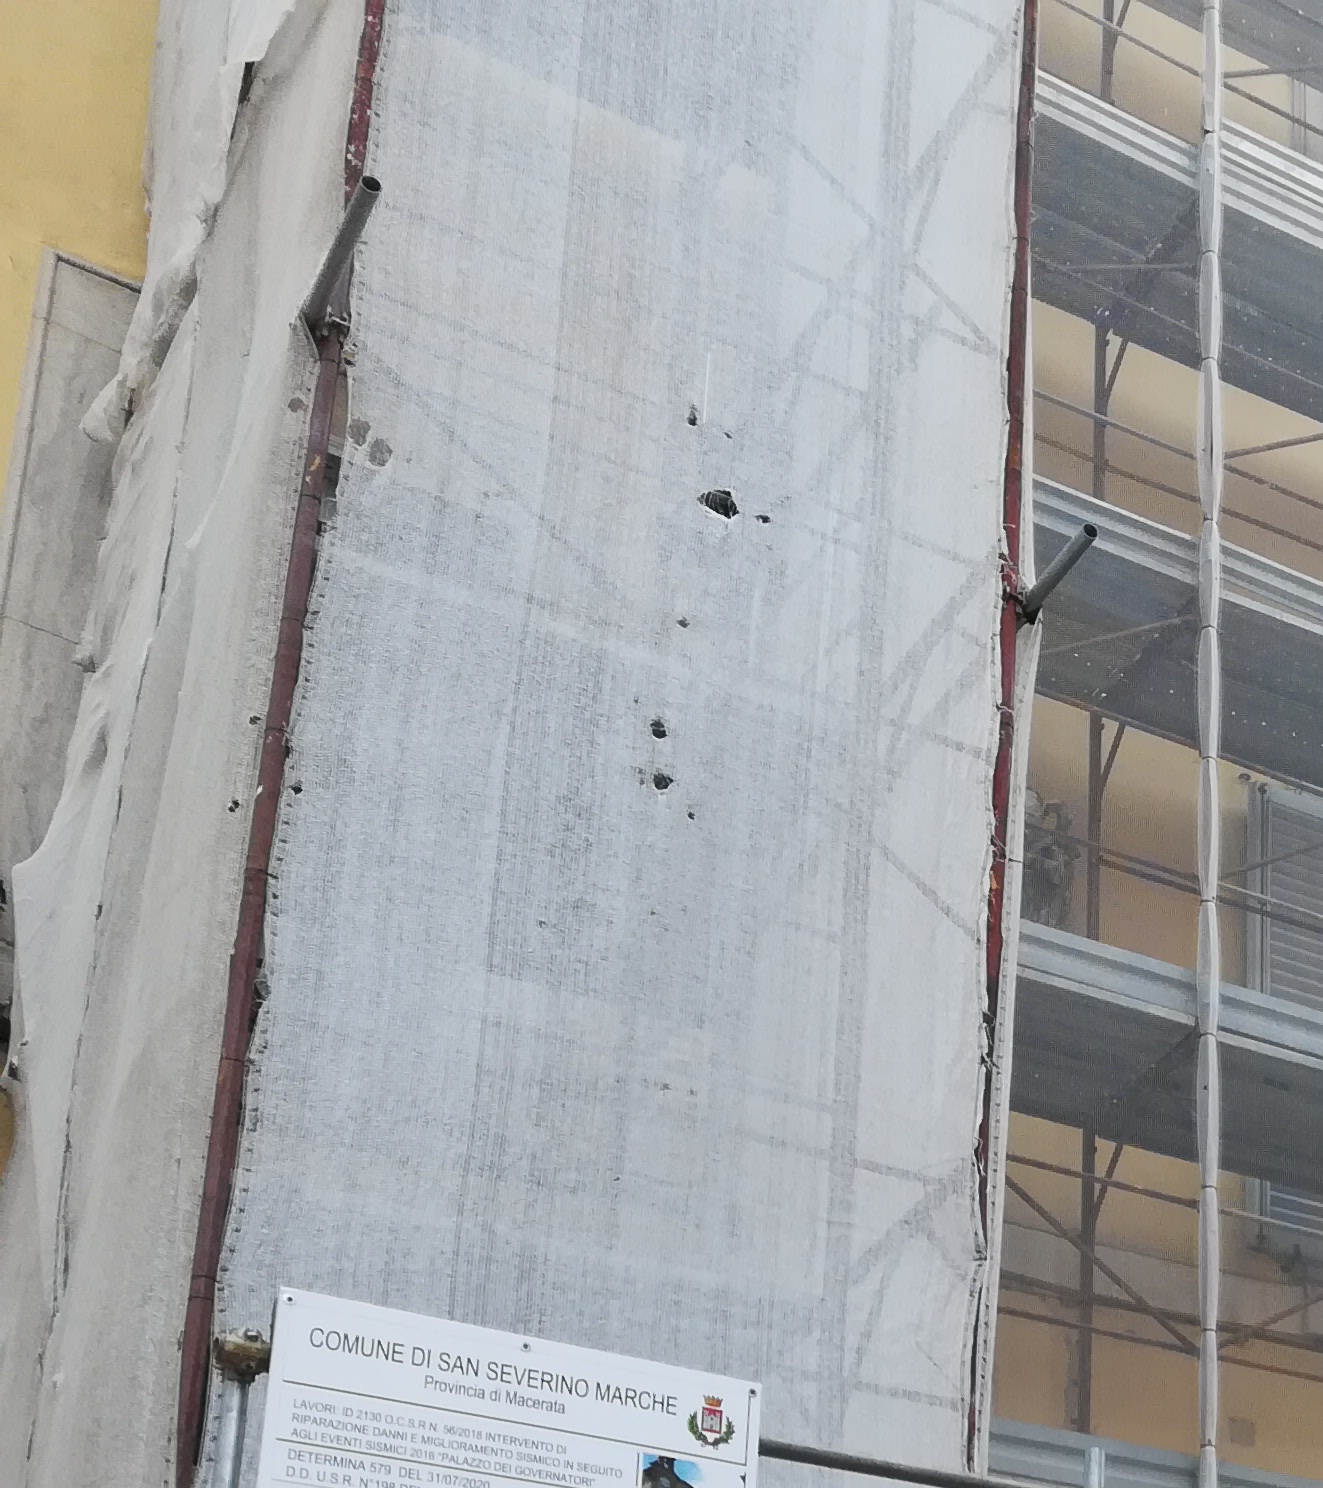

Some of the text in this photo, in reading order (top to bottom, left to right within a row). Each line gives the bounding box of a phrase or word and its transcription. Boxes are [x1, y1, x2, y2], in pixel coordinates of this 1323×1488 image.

[308, 1326, 677, 1417] COMUNE DI SAN SEVERINO MARCHE
[424, 1374, 485, 1400] Provincia
[505, 1389, 566, 1415] Macerata
[290, 1426, 317, 1440] AGLI
[320, 1431, 362, 1448] EVENTI
[365, 1439, 407, 1456] SISMICI
[493, 1461, 512, 1474] DEI
[291, 1411, 622, 1479] RIPARAZIONE DANNI MIGLIORAMENTO SISMICO SEGUITO
[356, 1409, 382, 1422] 2130
[485, 1432, 553, 1453] INTERVENTO
[287, 1447, 365, 1471] DETERMINA
[368, 1461, 391, 1476] 579
[398, 1466, 424, 1481] DEL
